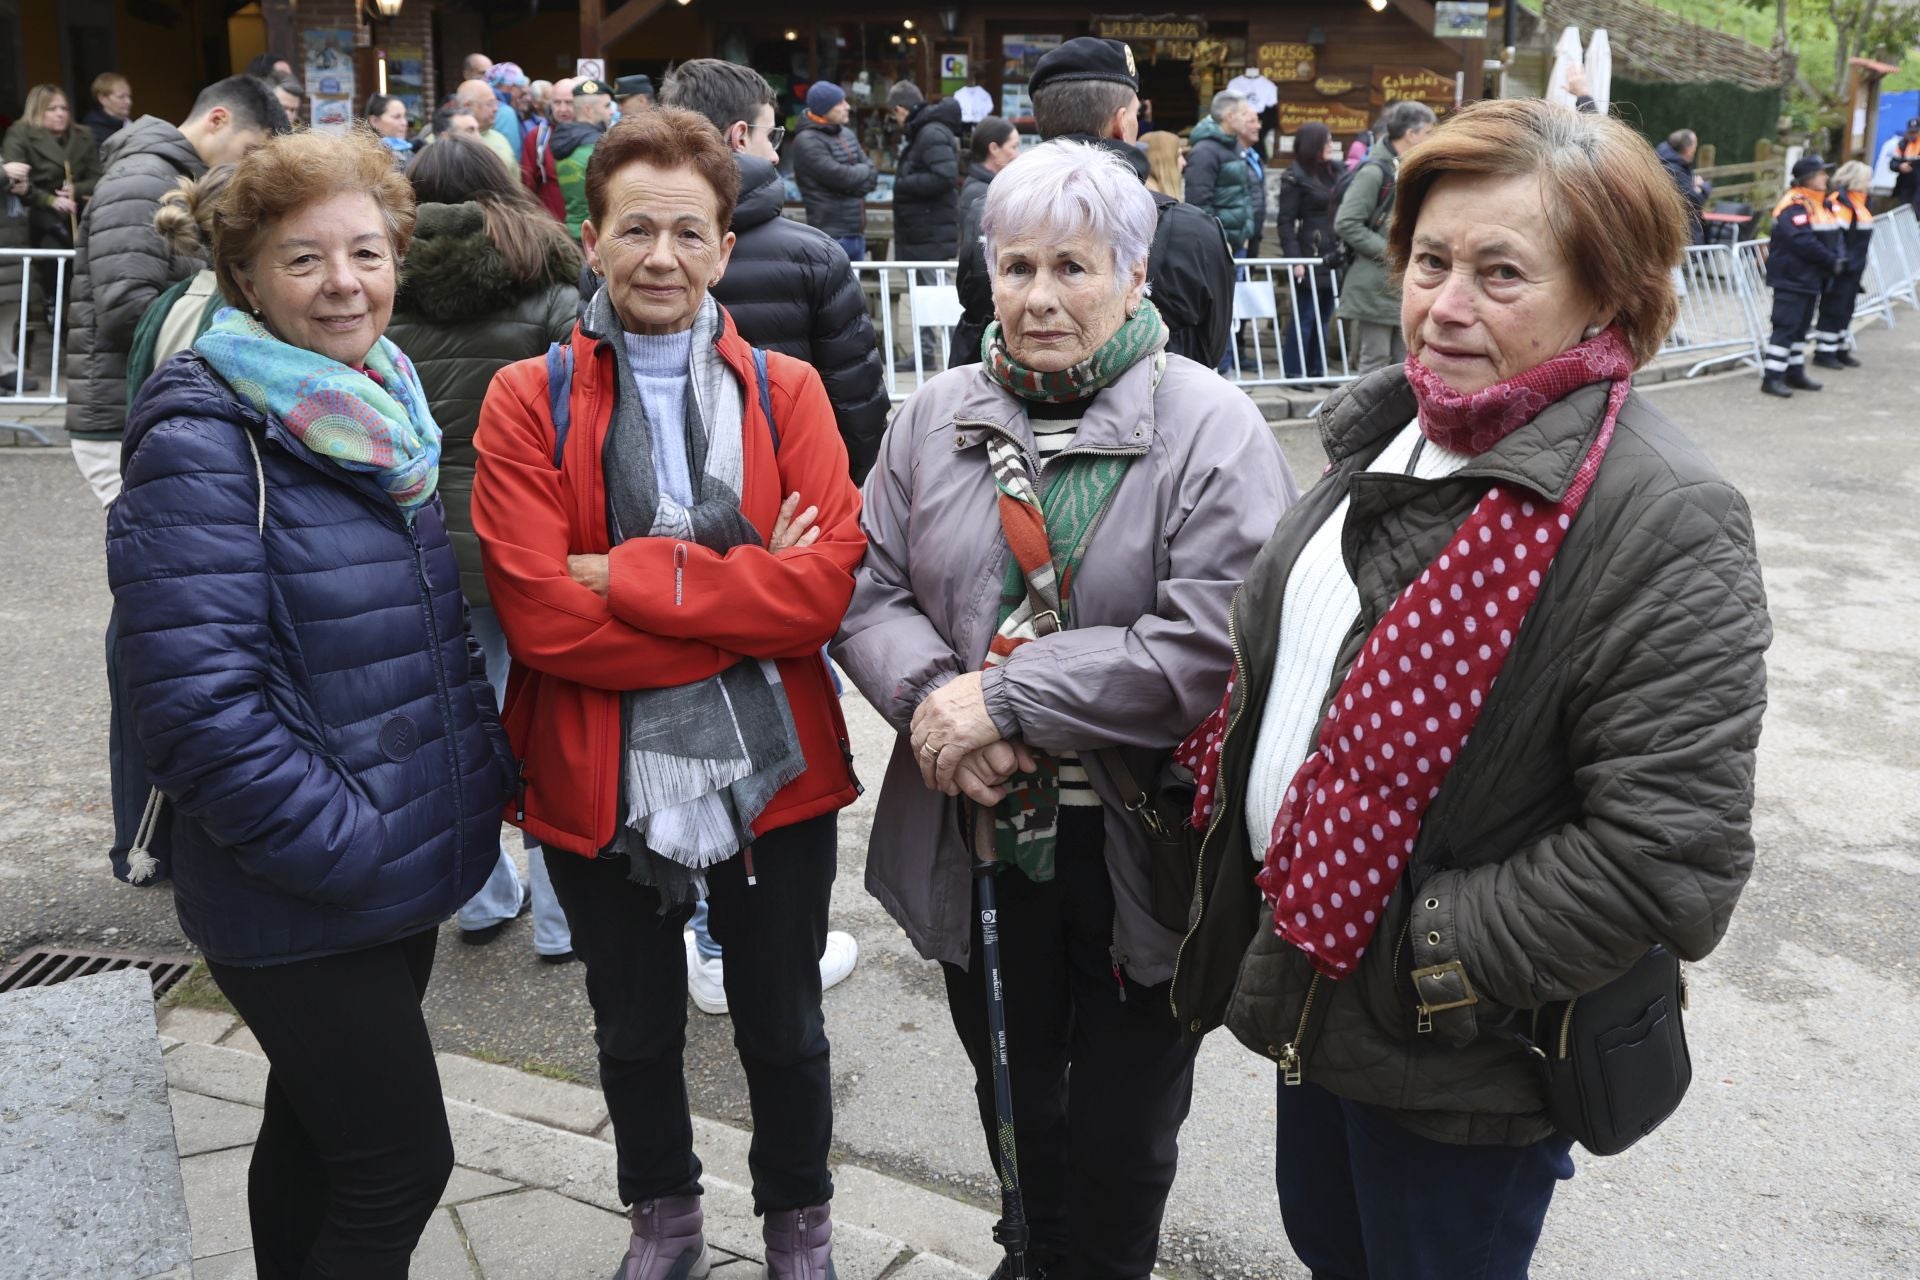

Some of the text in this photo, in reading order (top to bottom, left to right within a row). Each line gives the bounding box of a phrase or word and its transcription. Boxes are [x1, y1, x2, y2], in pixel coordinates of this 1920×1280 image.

[1259, 46, 1313, 60] QUESOS
[1382, 73, 1439, 88] Cabrales
[998, 1030, 1007, 1065] ULTRA LIGHT
